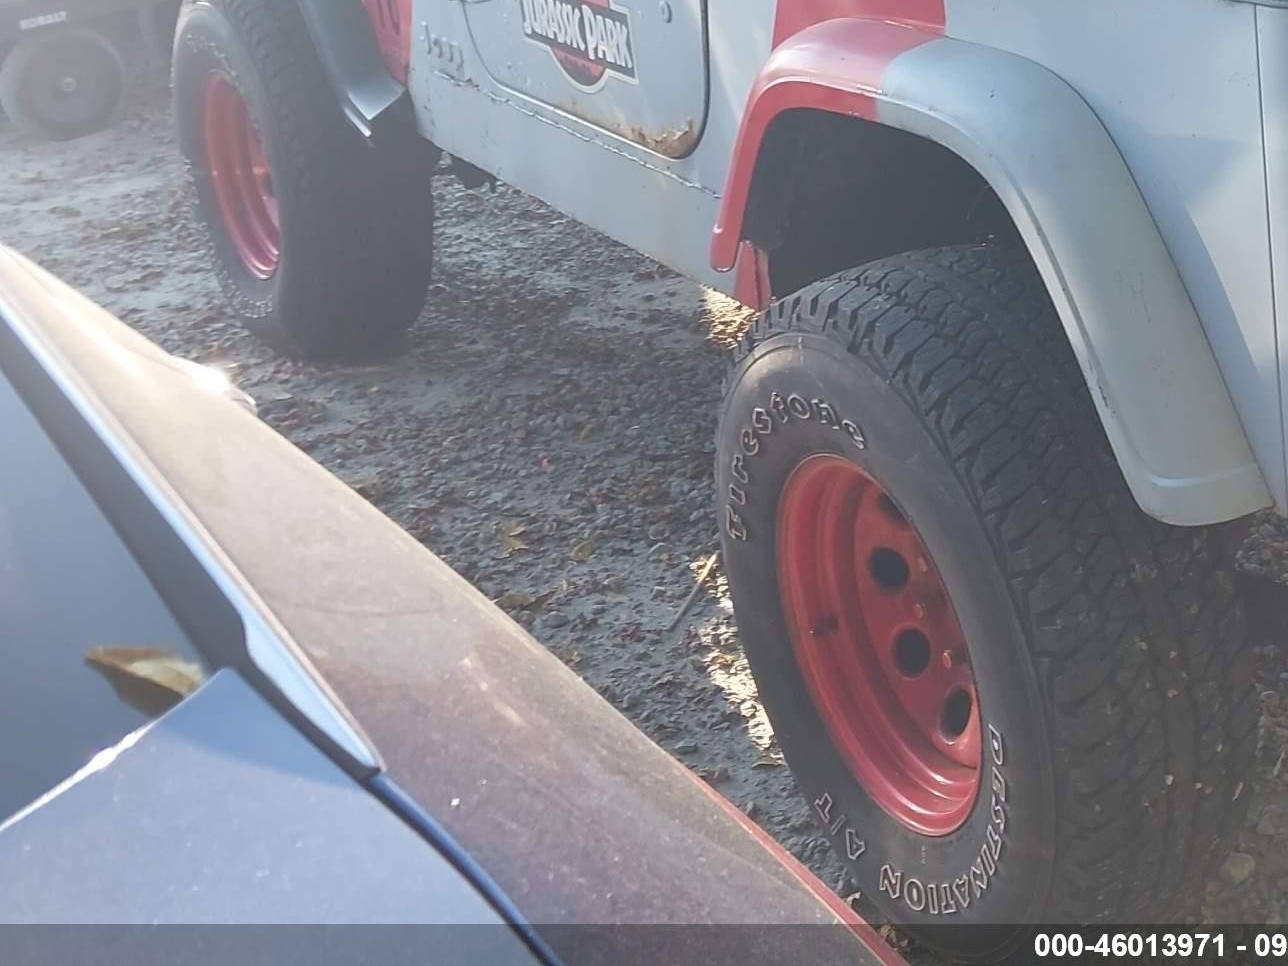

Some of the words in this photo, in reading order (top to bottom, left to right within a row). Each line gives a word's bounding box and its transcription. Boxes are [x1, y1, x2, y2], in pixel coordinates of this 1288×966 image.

[581, 3, 633, 69] PARK
[725, 391, 865, 542] Firestone
[813, 792, 866, 860] A/T
[878, 722, 1007, 915] DESTINATION
